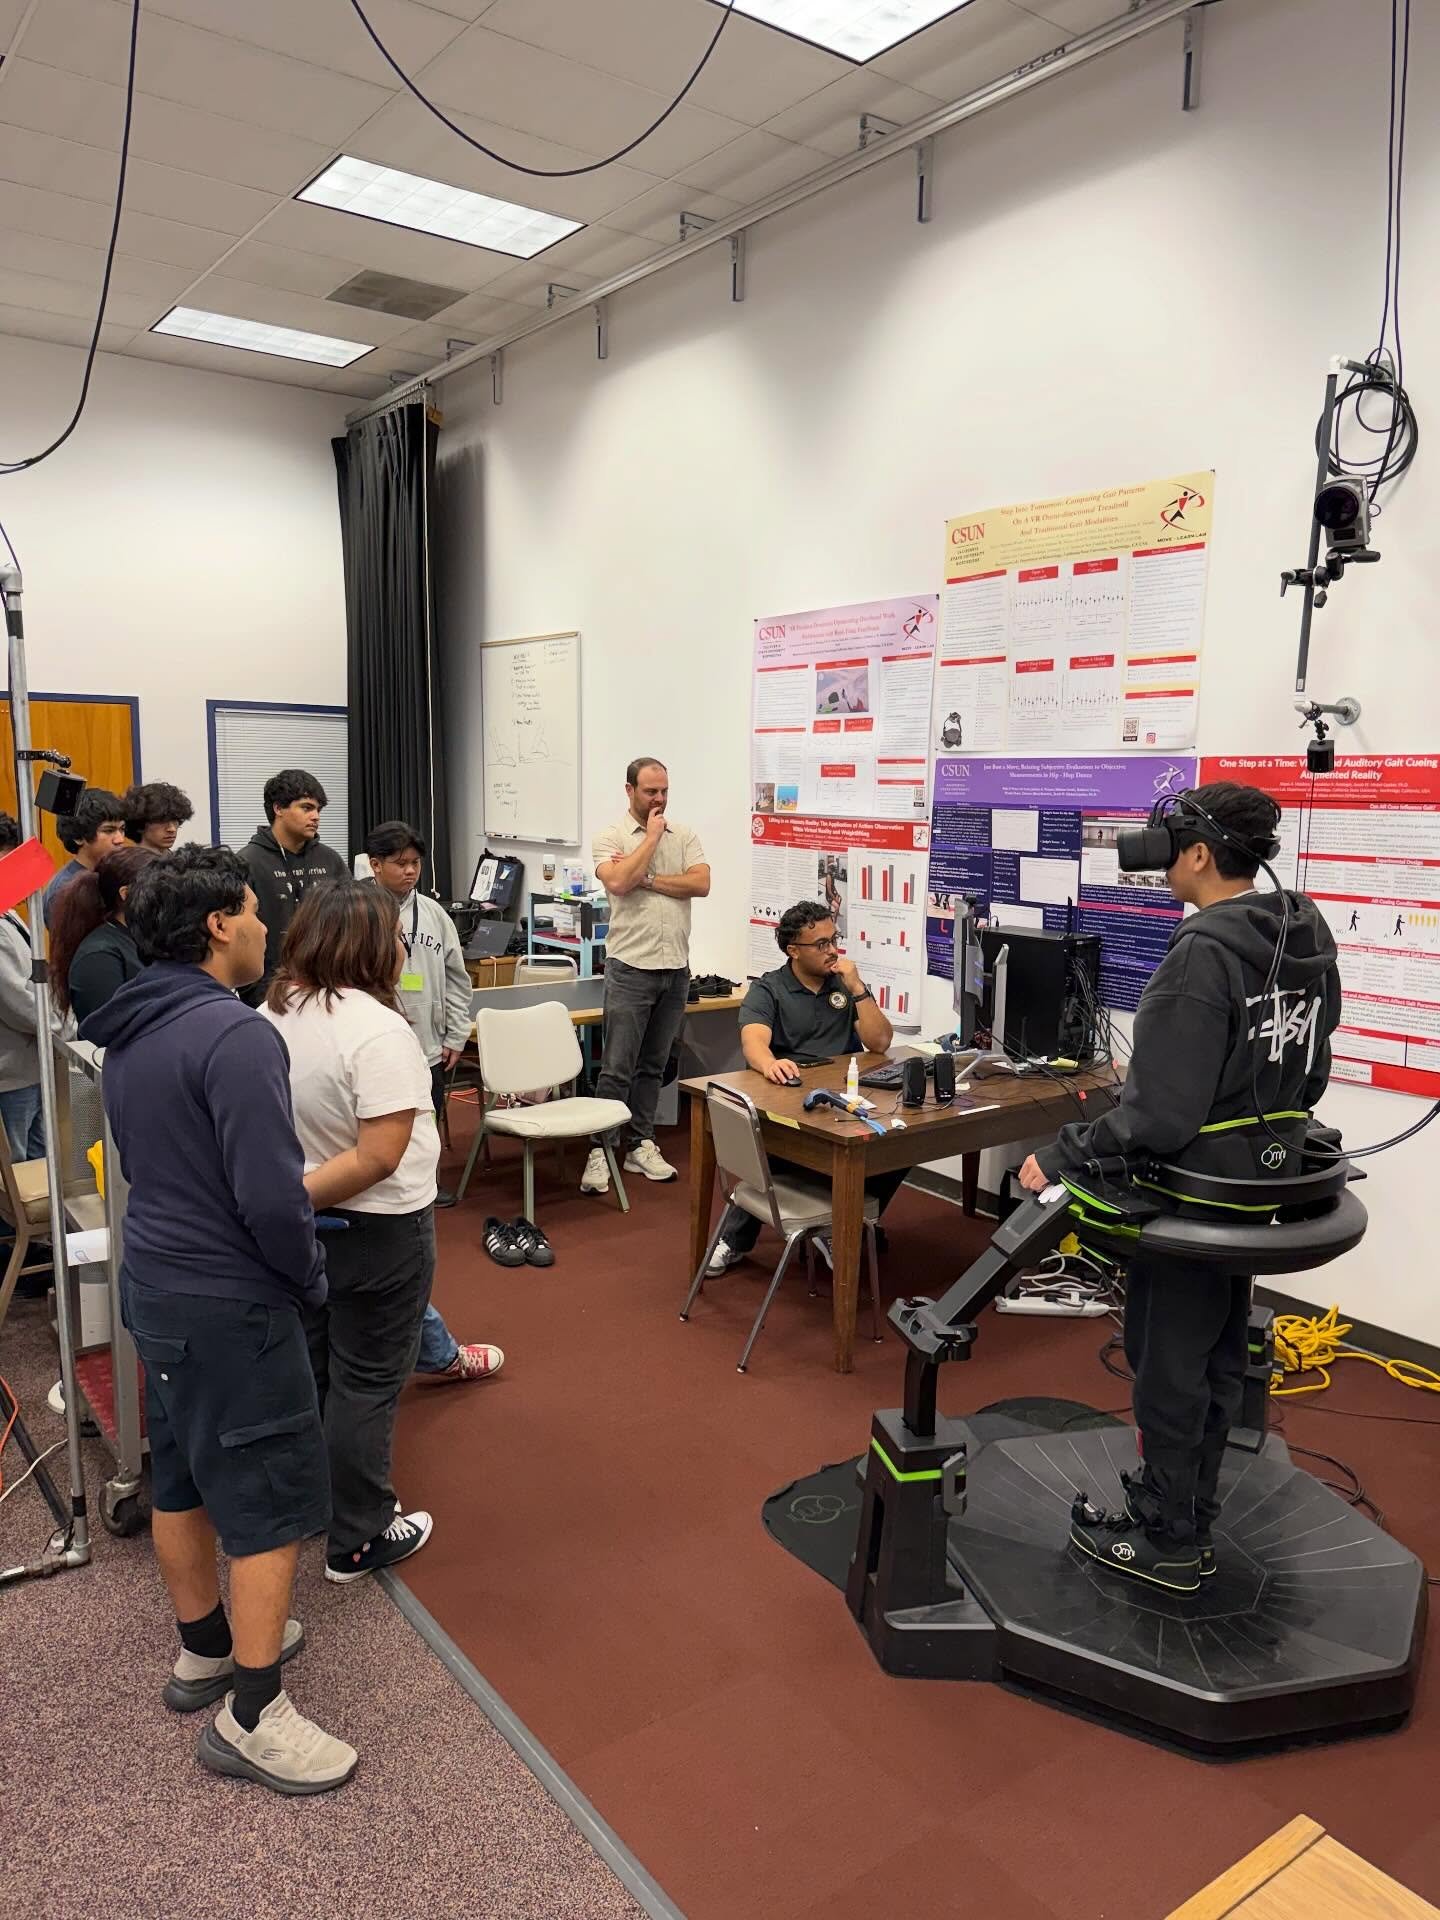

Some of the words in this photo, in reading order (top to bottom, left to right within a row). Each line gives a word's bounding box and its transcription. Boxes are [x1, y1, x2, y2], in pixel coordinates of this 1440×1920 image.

[1065, 494, 1101, 506] Comparing
[1031, 515, 1041, 523] VR
[1097, 500, 1129, 512] Treadmill
[951, 523, 986, 545] CSUN
[759, 624, 786, 641] CSUN
[1219, 759, 1237, 768] One
[1238, 758, 1257, 770] Step
[1257, 760, 1266, 768] at
[1274, 758, 1298, 768] Time:
[1344, 758, 1383, 769] Auditory
[1384, 757, 1405, 768] Gait
[1405, 757, 1438, 769] Cueing
[941, 764, 971, 777] CSUN
[1300, 770, 1350, 780] Augmented
[1350, 770, 1383, 782] Reality
[399, 932, 442, 956] UTICA
